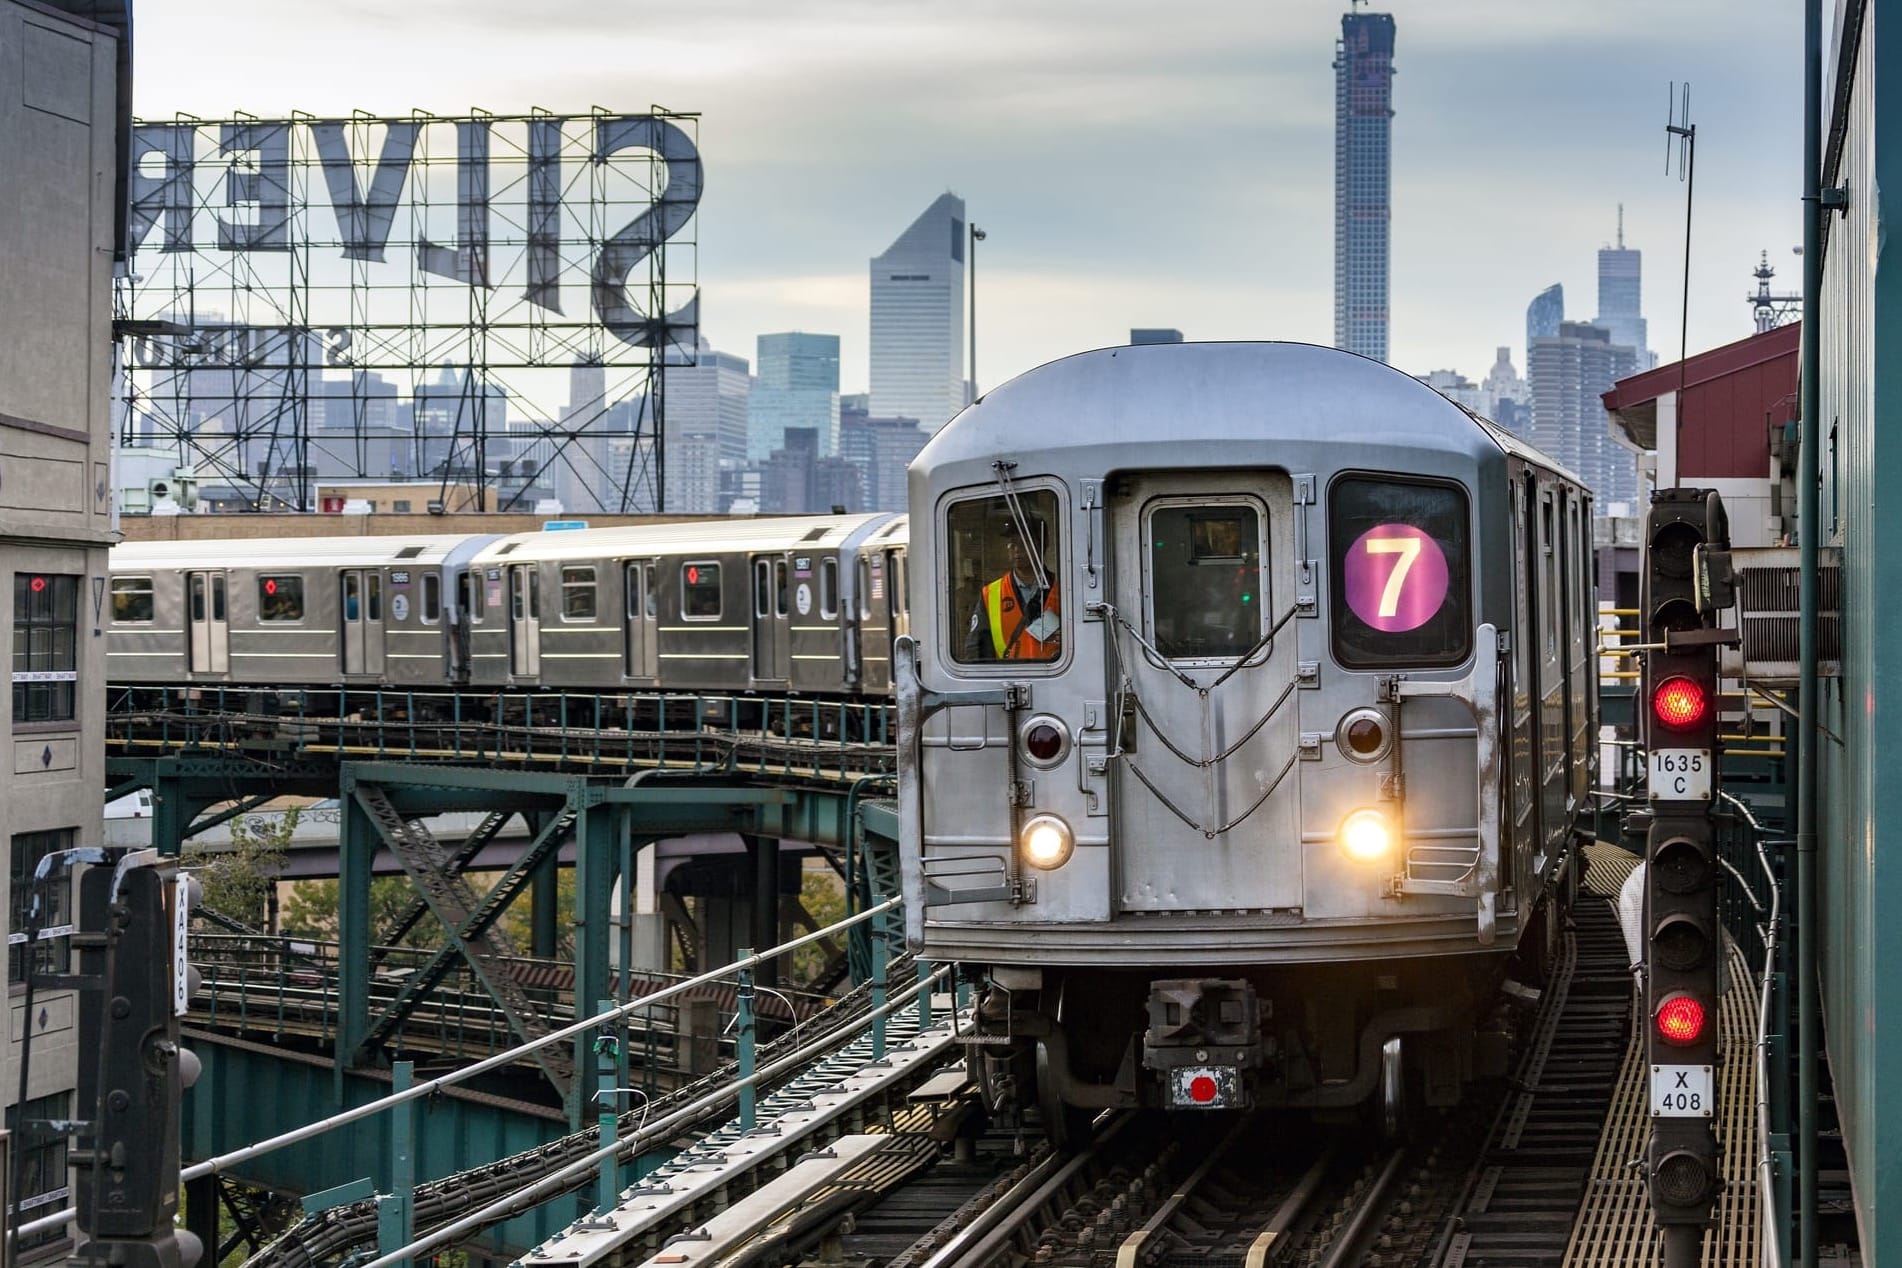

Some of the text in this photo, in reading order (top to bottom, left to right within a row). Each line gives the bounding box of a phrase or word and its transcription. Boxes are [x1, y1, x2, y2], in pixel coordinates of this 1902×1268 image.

[1366, 538, 1421, 617] 7
[1658, 755, 1701, 772] 1635
[1674, 776, 1686, 794] C
[178, 887, 186, 1001] XA406
[1675, 1071, 1689, 1089] X
[1662, 1093, 1701, 1111] 408
